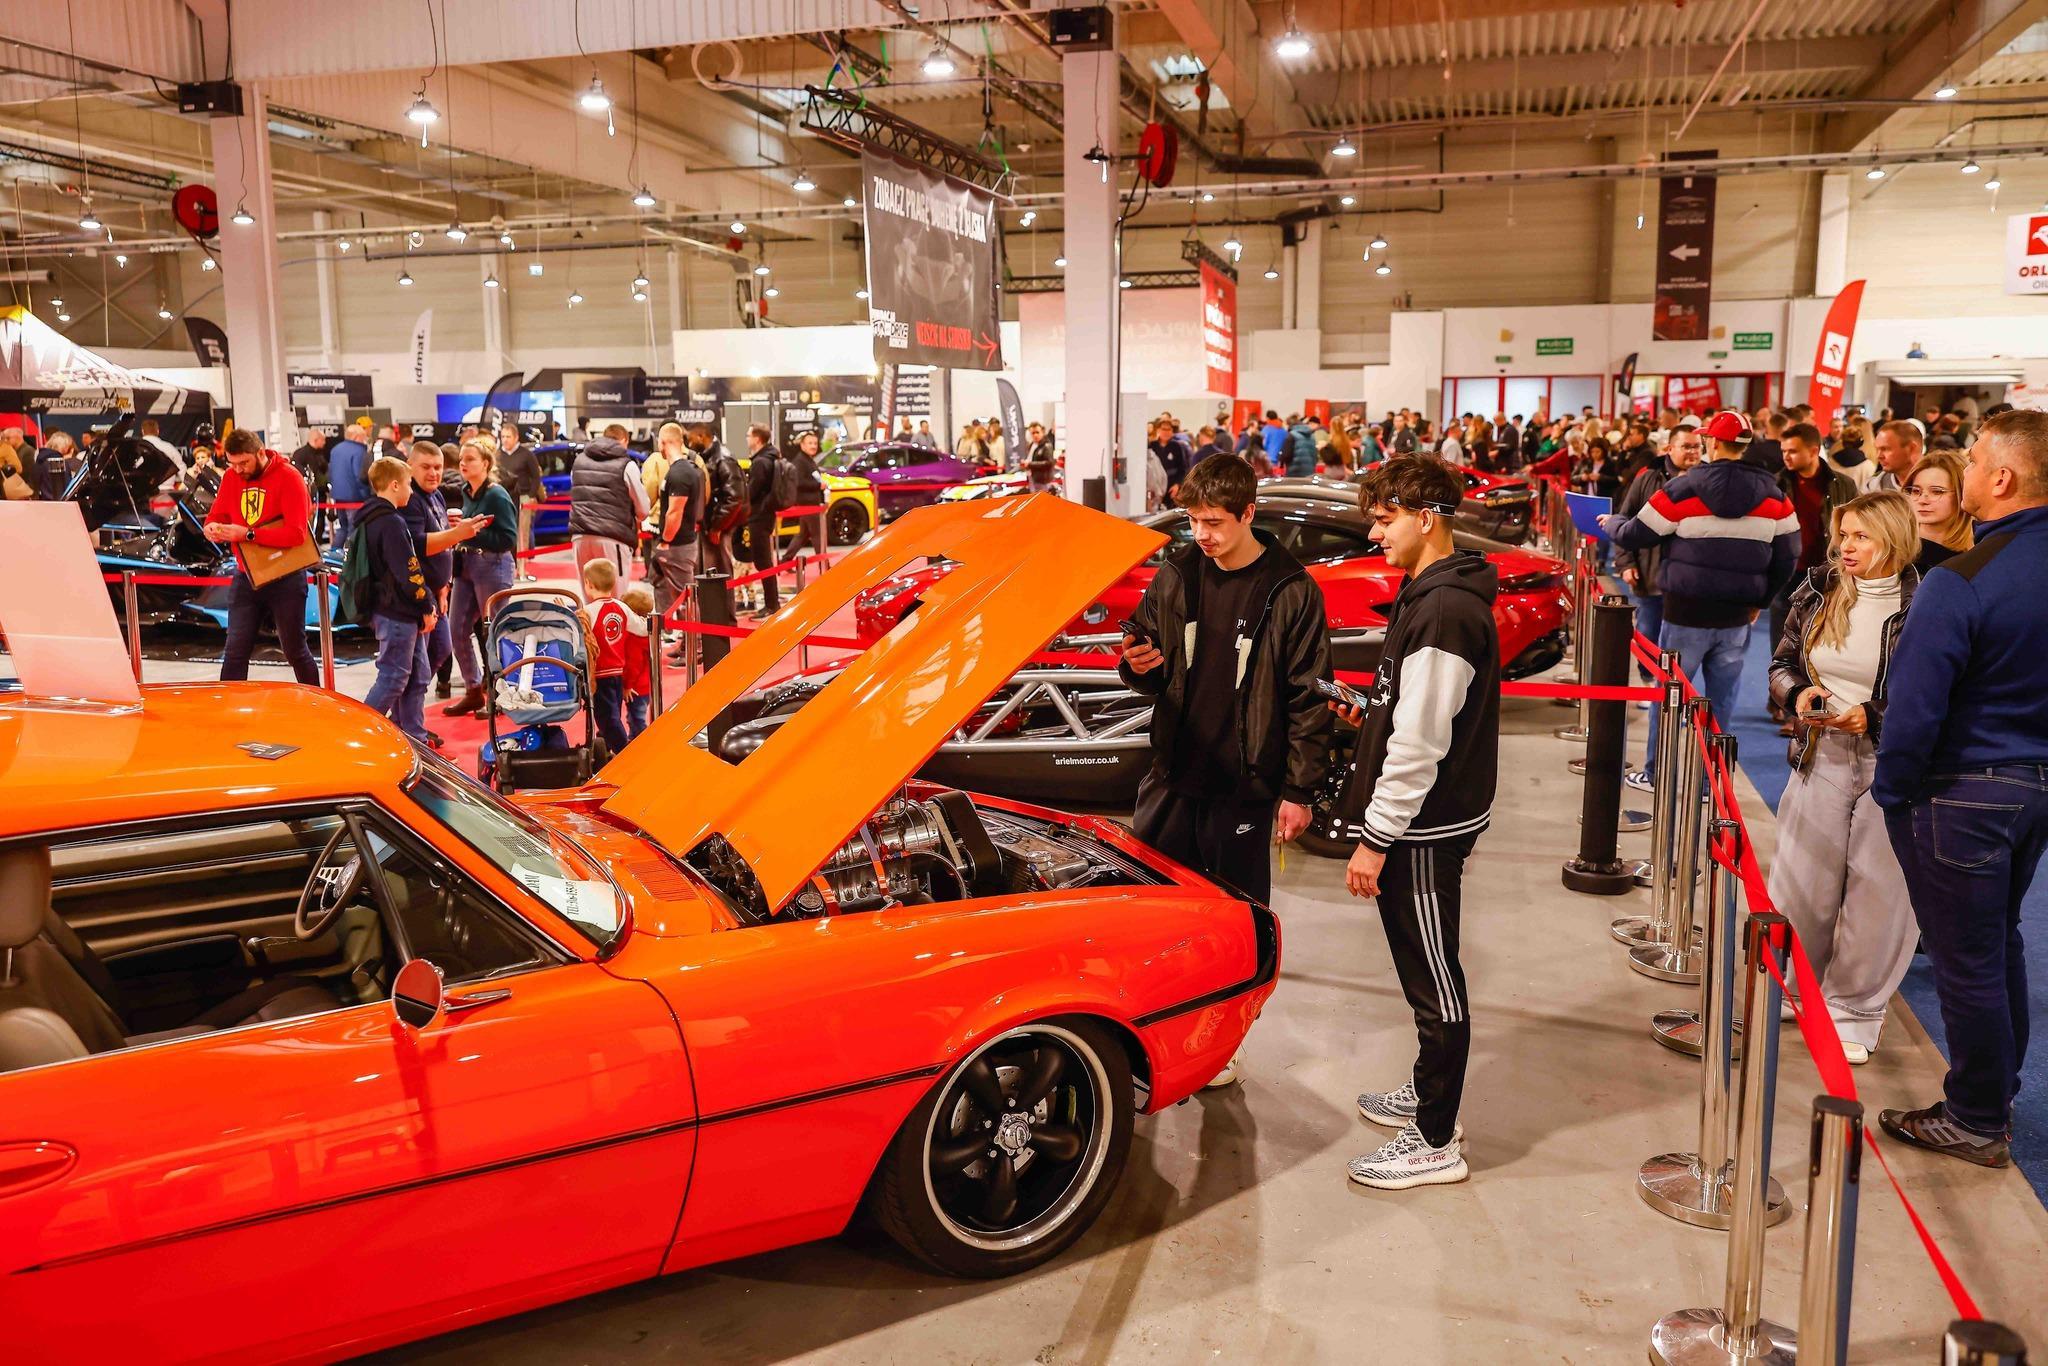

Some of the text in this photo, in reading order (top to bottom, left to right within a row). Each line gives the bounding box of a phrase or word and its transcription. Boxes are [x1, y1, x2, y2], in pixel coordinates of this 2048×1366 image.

[873, 175, 905, 217] ZOBACZ
[2018, 264, 2048, 278] ORL
[1055, 755, 1120, 766] arielmotor.co.uk
